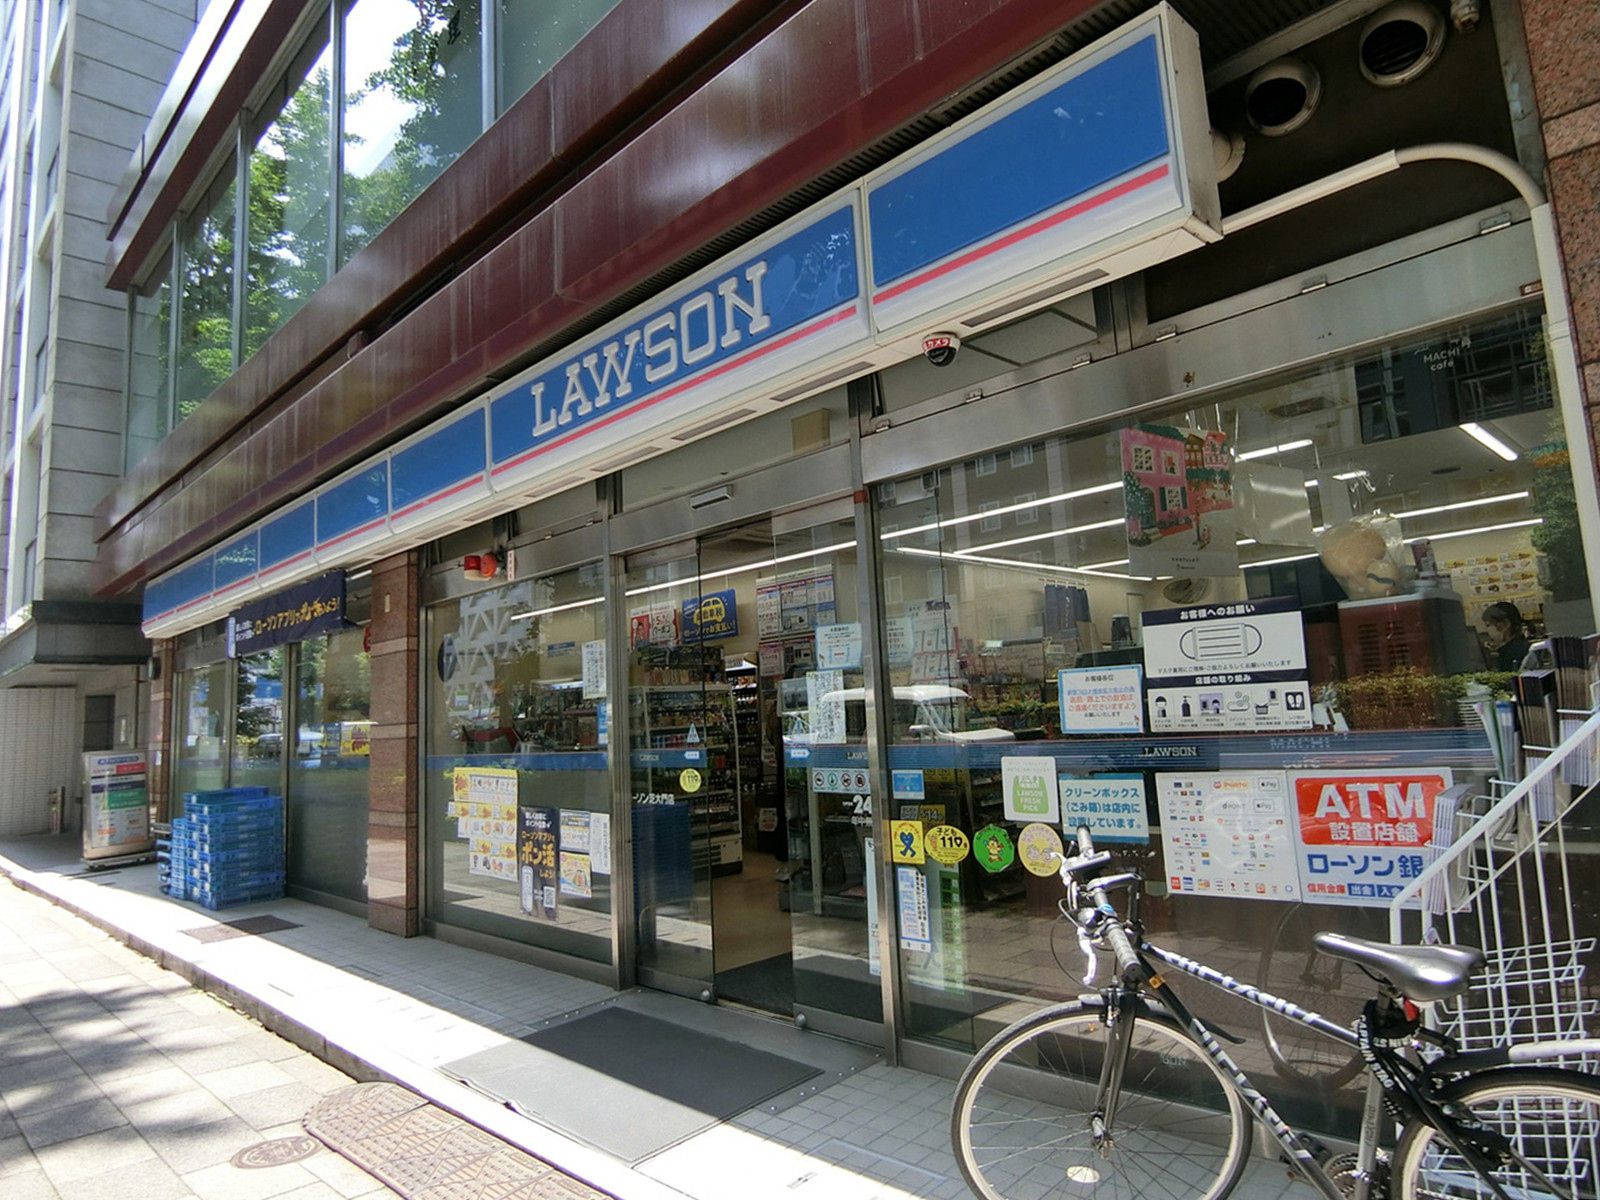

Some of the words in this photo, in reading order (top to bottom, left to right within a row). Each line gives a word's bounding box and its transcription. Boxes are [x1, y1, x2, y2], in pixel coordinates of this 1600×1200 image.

[531, 260, 770, 437] LAWSON
[1180, 604, 1256, 620] お客様へのお願い
[1143, 746, 1198, 757] LAWSON
[1065, 787, 1140, 798] クリーンボックス
[1315, 782, 1426, 819] ATM
[1066, 802, 1141, 814] (ごみ箱)は店内に
[1068, 816, 1142, 829] 設置しています。
[1328, 821, 1419, 843] 設置店舗
[522, 841, 555, 868] ポン活
[1307, 882, 1347, 895] 信用金庫
[1350, 884, 1374, 896] 出金
[1359, 1014, 1377, 1063] CAPTAIN
